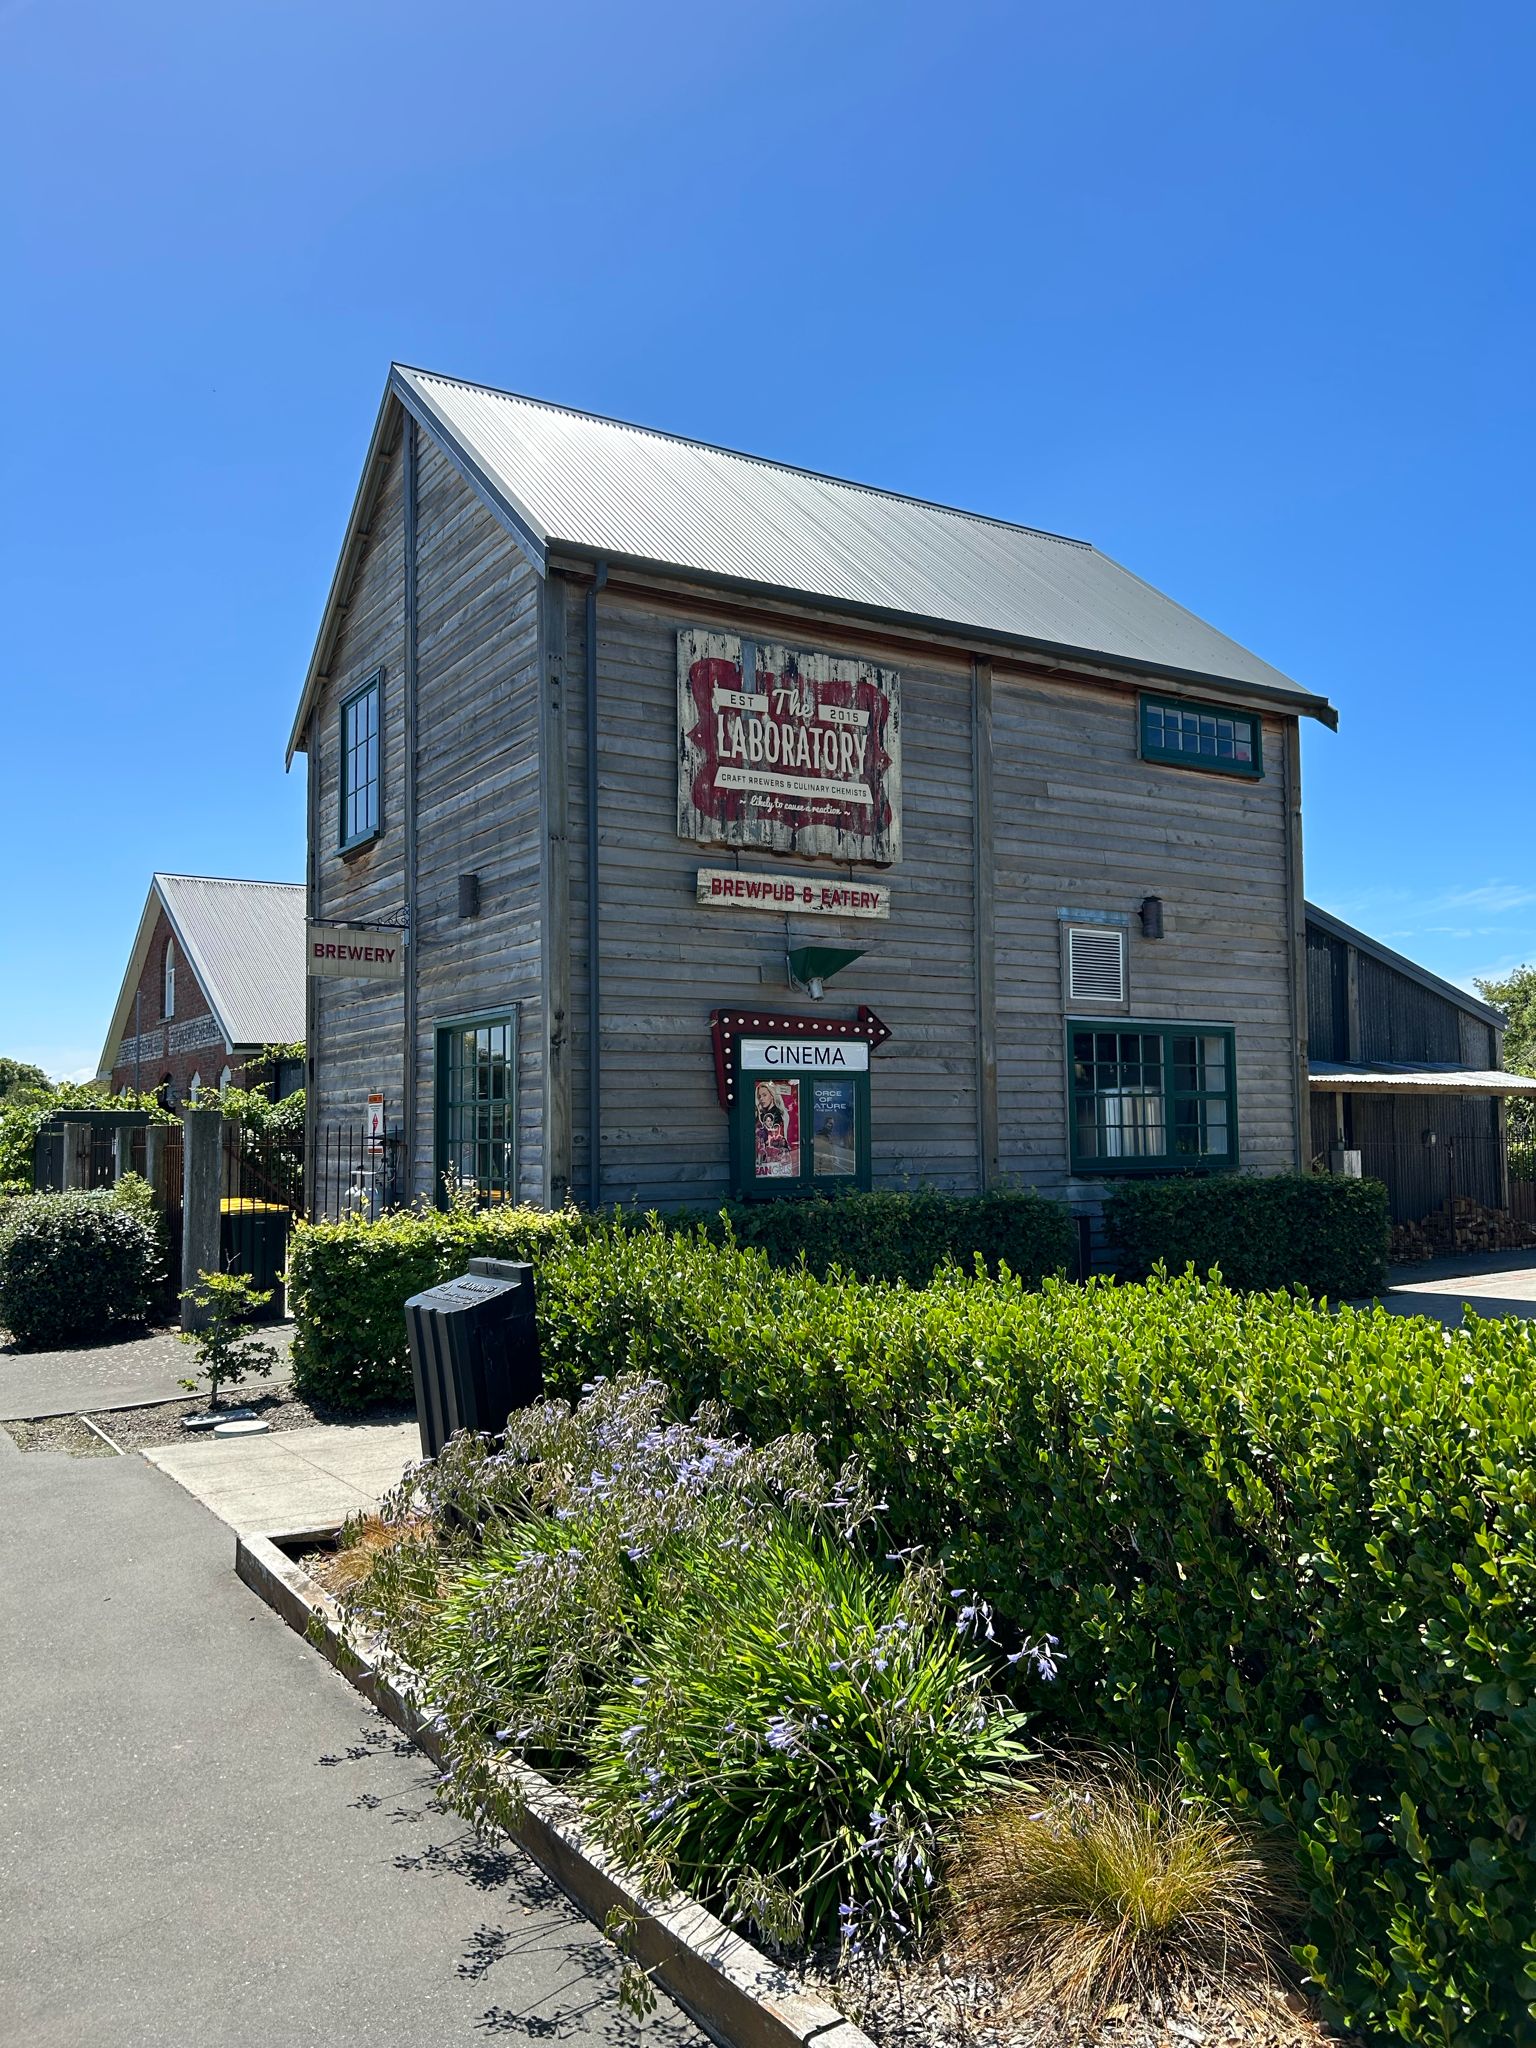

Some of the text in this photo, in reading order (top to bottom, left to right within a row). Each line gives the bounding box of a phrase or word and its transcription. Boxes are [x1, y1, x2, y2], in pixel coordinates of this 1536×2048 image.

[730, 694, 754, 707] EST
[772, 688, 815, 717] The
[830, 709, 859, 723] 2015
[717, 714, 867, 775] LABORATORY
[721, 773, 746, 784] CRAFT
[786, 781, 792, 789] &
[793, 782, 830, 793] CULINARY
[831, 786, 867, 798] CHEMISTS
[774, 797, 783, 809] to
[711, 878, 880, 909] BREWPUB & EATERY
[313, 943, 396, 963] BREWERY
[764, 1045, 846, 1066] CINEMA
